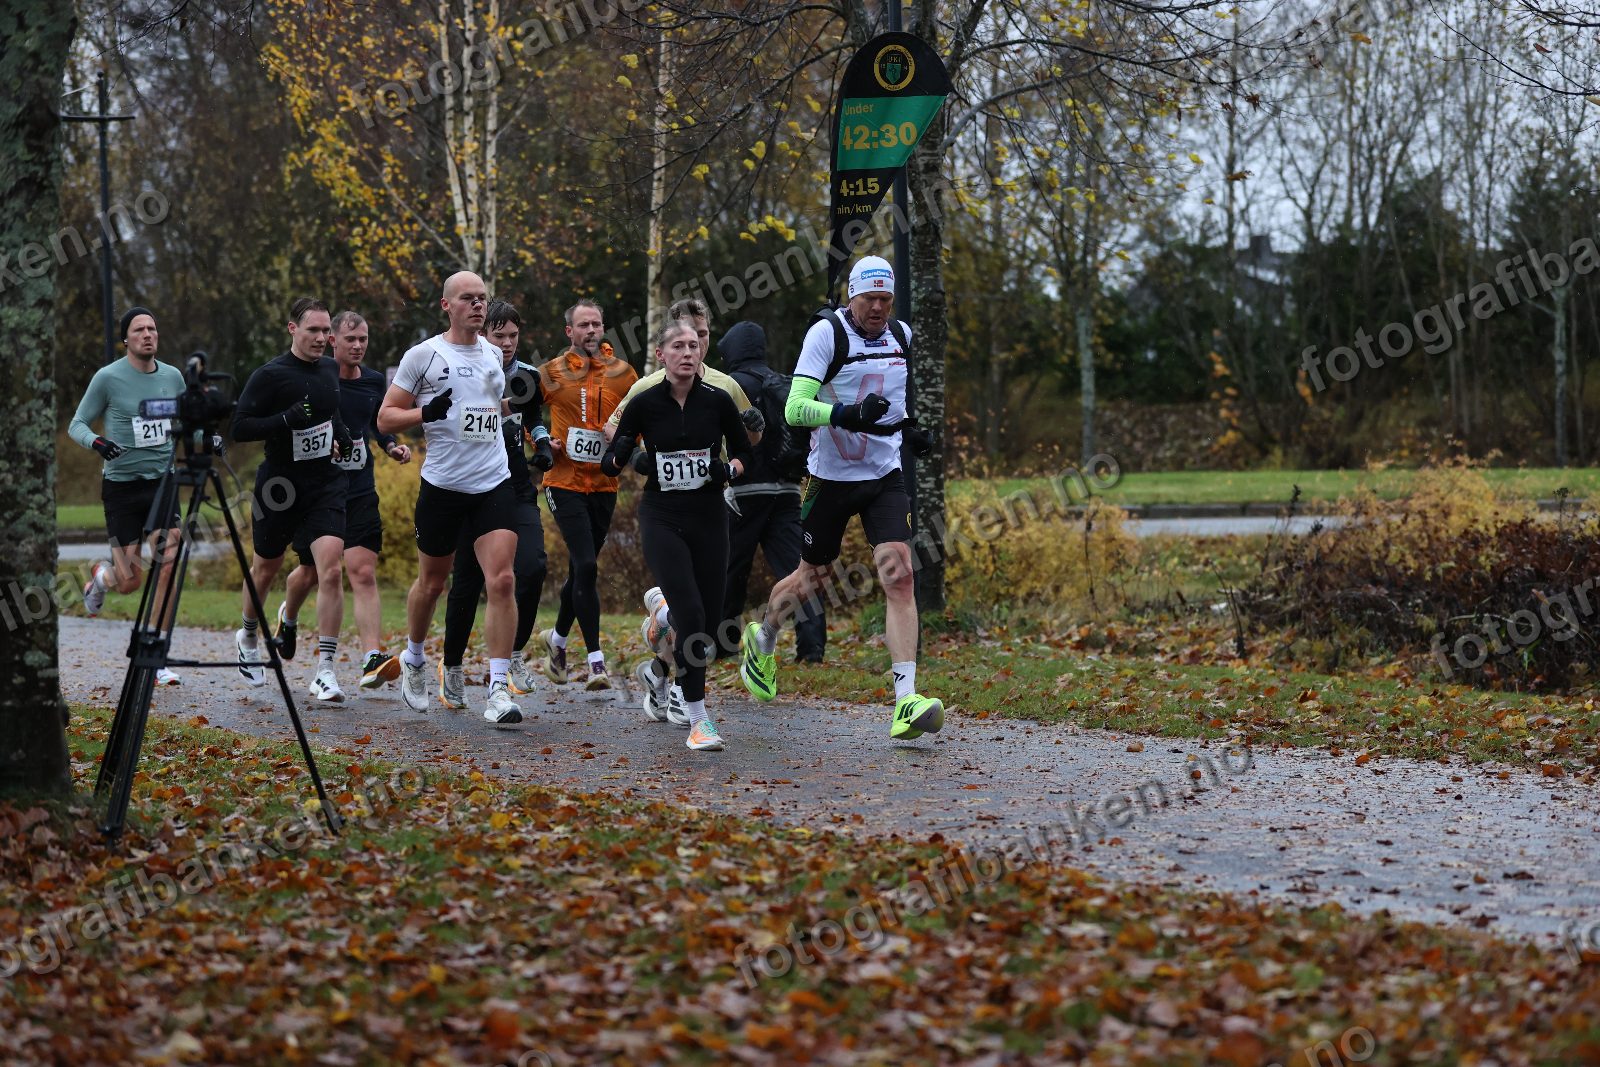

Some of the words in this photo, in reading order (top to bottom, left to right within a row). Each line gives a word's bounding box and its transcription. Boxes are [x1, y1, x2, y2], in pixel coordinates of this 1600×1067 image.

[842, 121, 918, 151] 42:30
[840, 177, 880, 197] 4:15
[142, 422, 164, 440] 211
[463, 413, 498, 432] 2140
[302, 432, 327, 453] 357
[574, 438, 602, 457] 640
[662, 458, 708, 482] 9118
